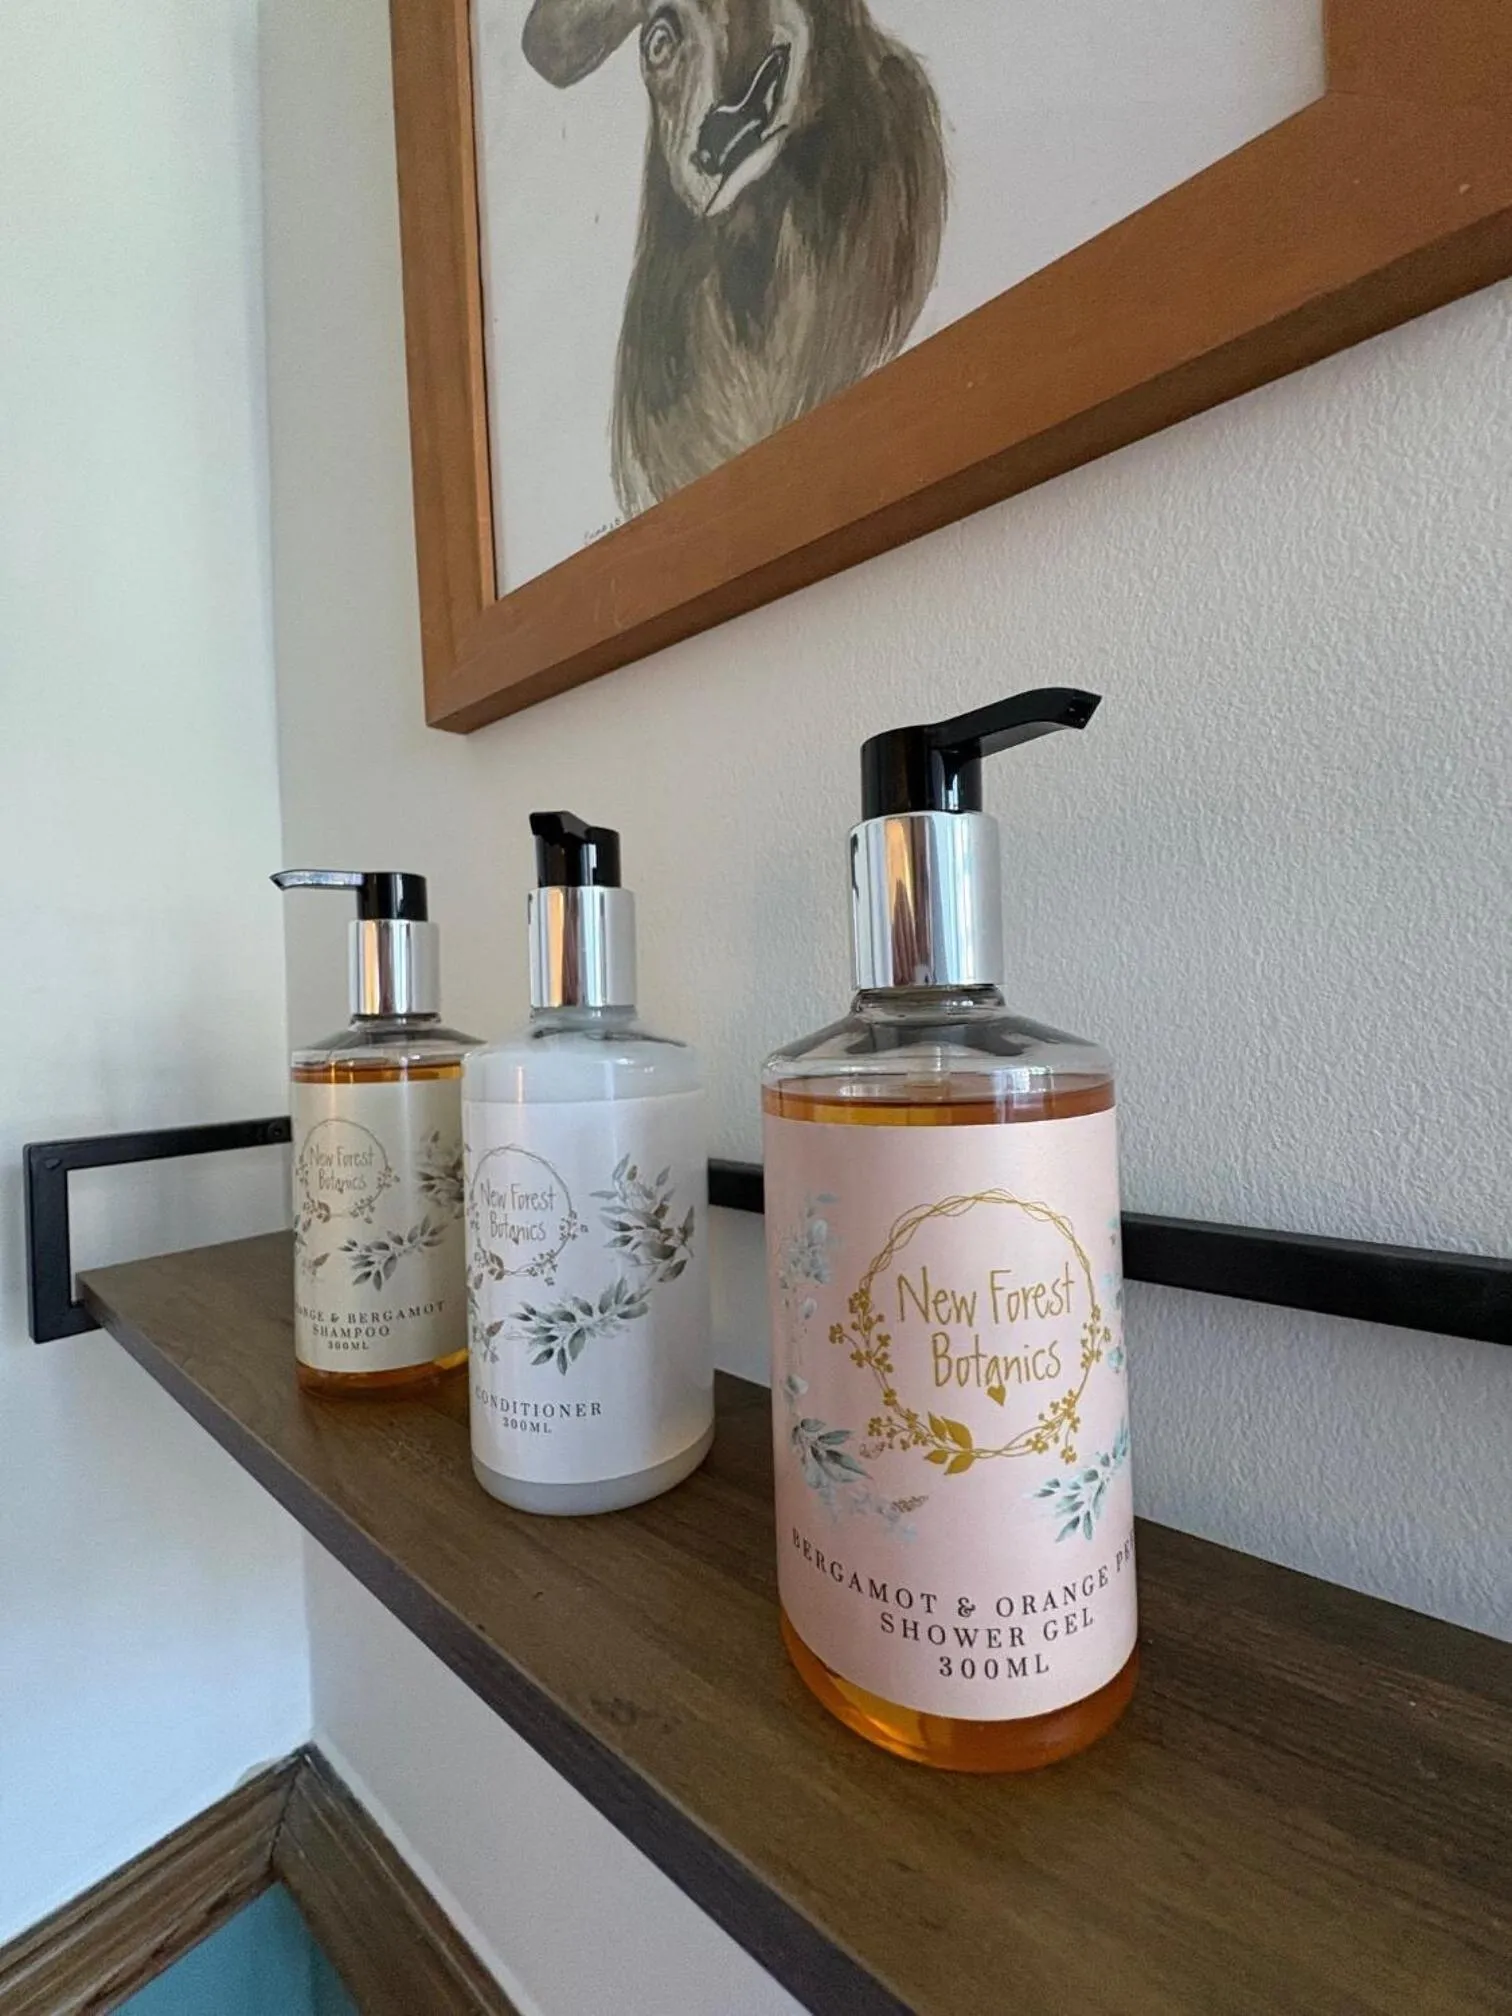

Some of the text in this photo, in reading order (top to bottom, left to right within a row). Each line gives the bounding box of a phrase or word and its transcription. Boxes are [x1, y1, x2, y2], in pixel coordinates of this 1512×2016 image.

[309, 1144, 375, 1168] New Forest
[319, 1168, 367, 1191] Botanics
[480, 1178, 556, 1212] New Forest
[490, 1210, 546, 1241] Botanics
[897, 1261, 1075, 1328] New Forest
[347, 1302, 445, 1324] BERGAMOT
[312, 1323, 390, 1339] SHAMPOO
[328, 1340, 369, 1351] 300ML
[932, 1331, 1061, 1388] Botanics
[475, 1385, 602, 1418] CONDITIONER
[502, 1416, 552, 1434] 300ML
[792, 1527, 937, 1614] BERGAMOT
[957, 1597, 976, 1618] &
[996, 1564, 1108, 1619] ORANGE
[880, 1607, 1095, 1649] SHOWER GEL
[938, 1656, 1050, 1680] 300ML
